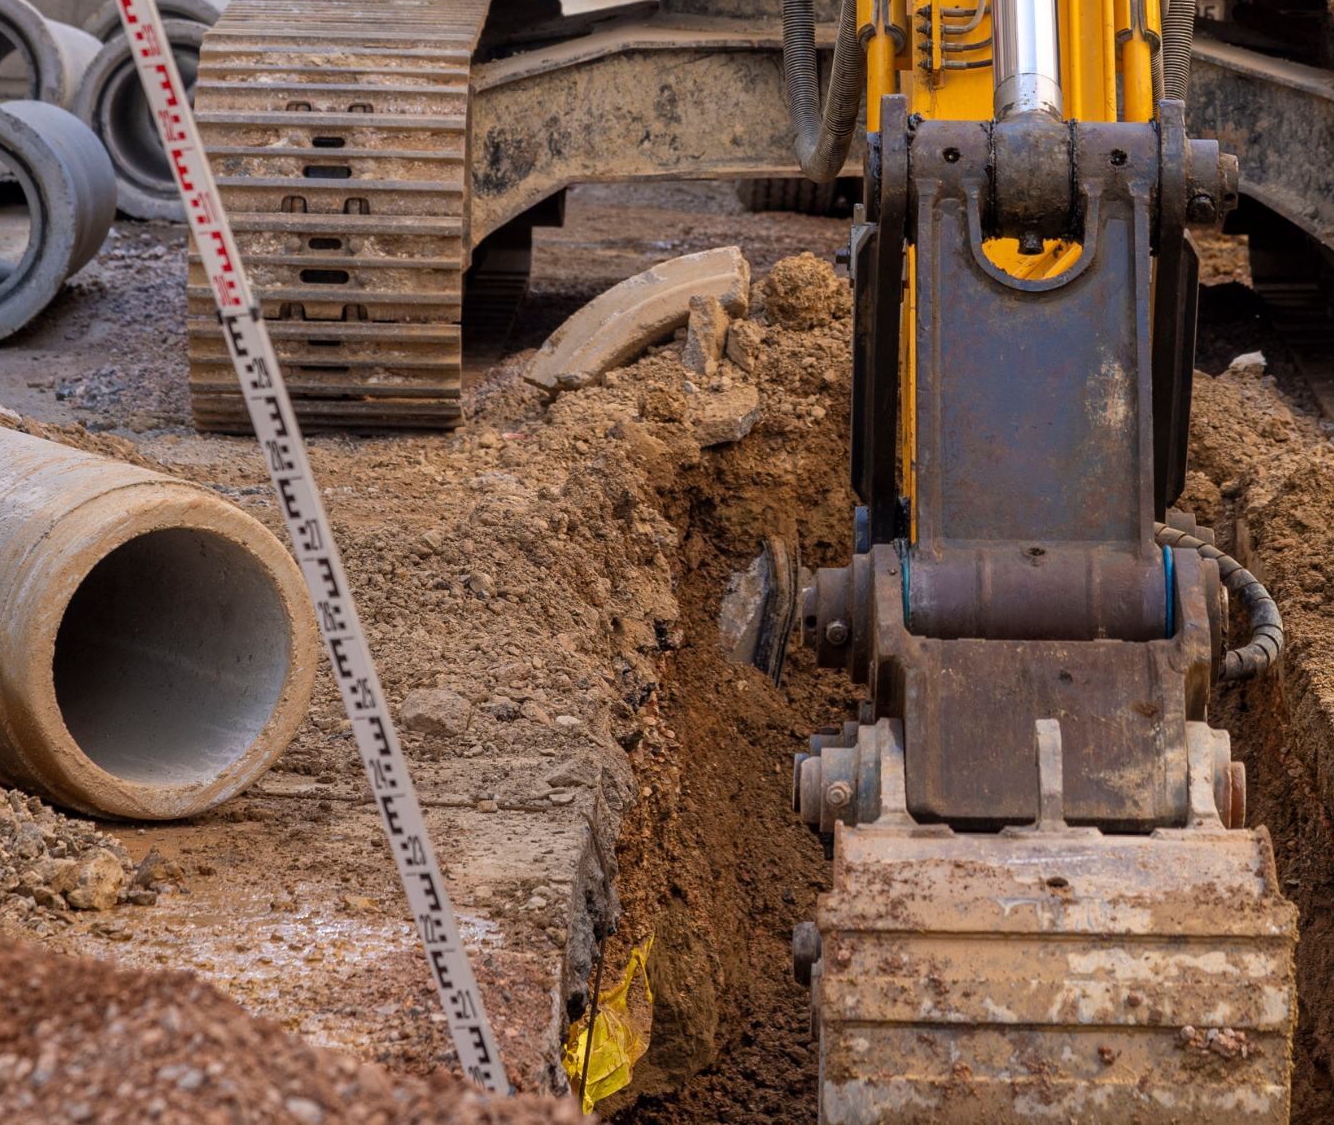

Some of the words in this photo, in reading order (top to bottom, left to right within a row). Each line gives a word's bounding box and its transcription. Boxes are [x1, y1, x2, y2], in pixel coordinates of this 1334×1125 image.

[254, 357, 274, 389] 29
[265, 440, 286, 472] 28
[305, 519, 323, 550] 27
[317, 601, 338, 632] 26
[357, 678, 376, 708] 25
[369, 759, 388, 789] 24
[407, 836, 427, 866] 23
[419, 914, 438, 944] 22
[458, 990, 477, 1019] 21
